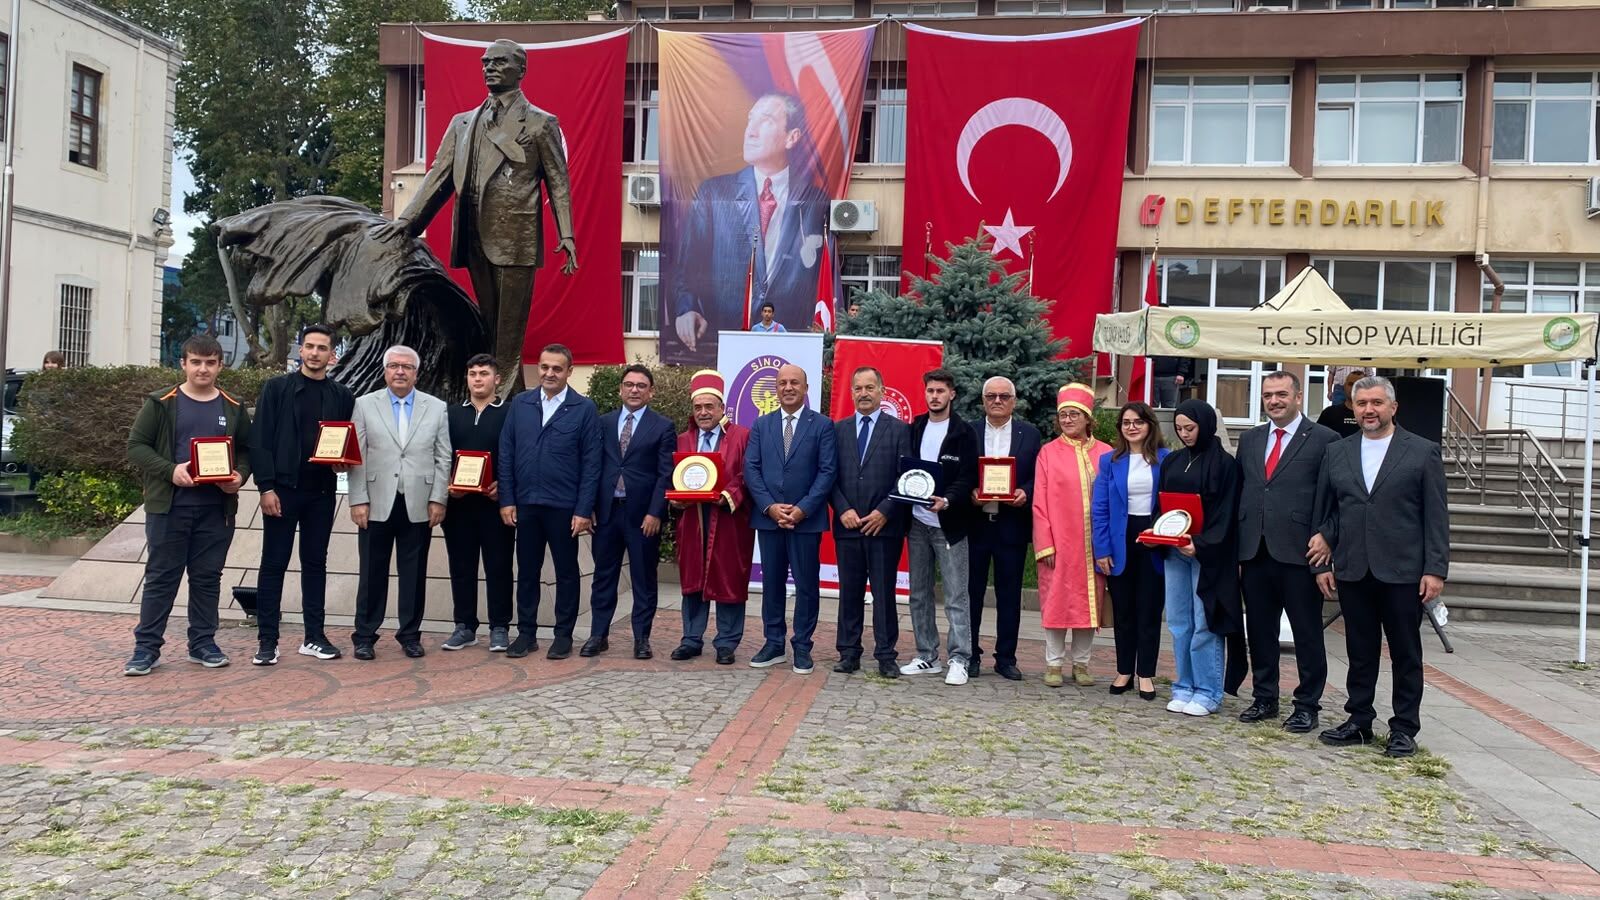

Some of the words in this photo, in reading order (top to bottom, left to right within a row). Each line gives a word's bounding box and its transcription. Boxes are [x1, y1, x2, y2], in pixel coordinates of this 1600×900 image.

[1175, 198, 1445, 227] DEFTERDARLIK
[1257, 326, 1297, 346] T.C.
[1304, 322, 1378, 346] SİNOP
[1384, 322, 1483, 346] VALİLİĞİ
[751, 357, 782, 371] SİNO
